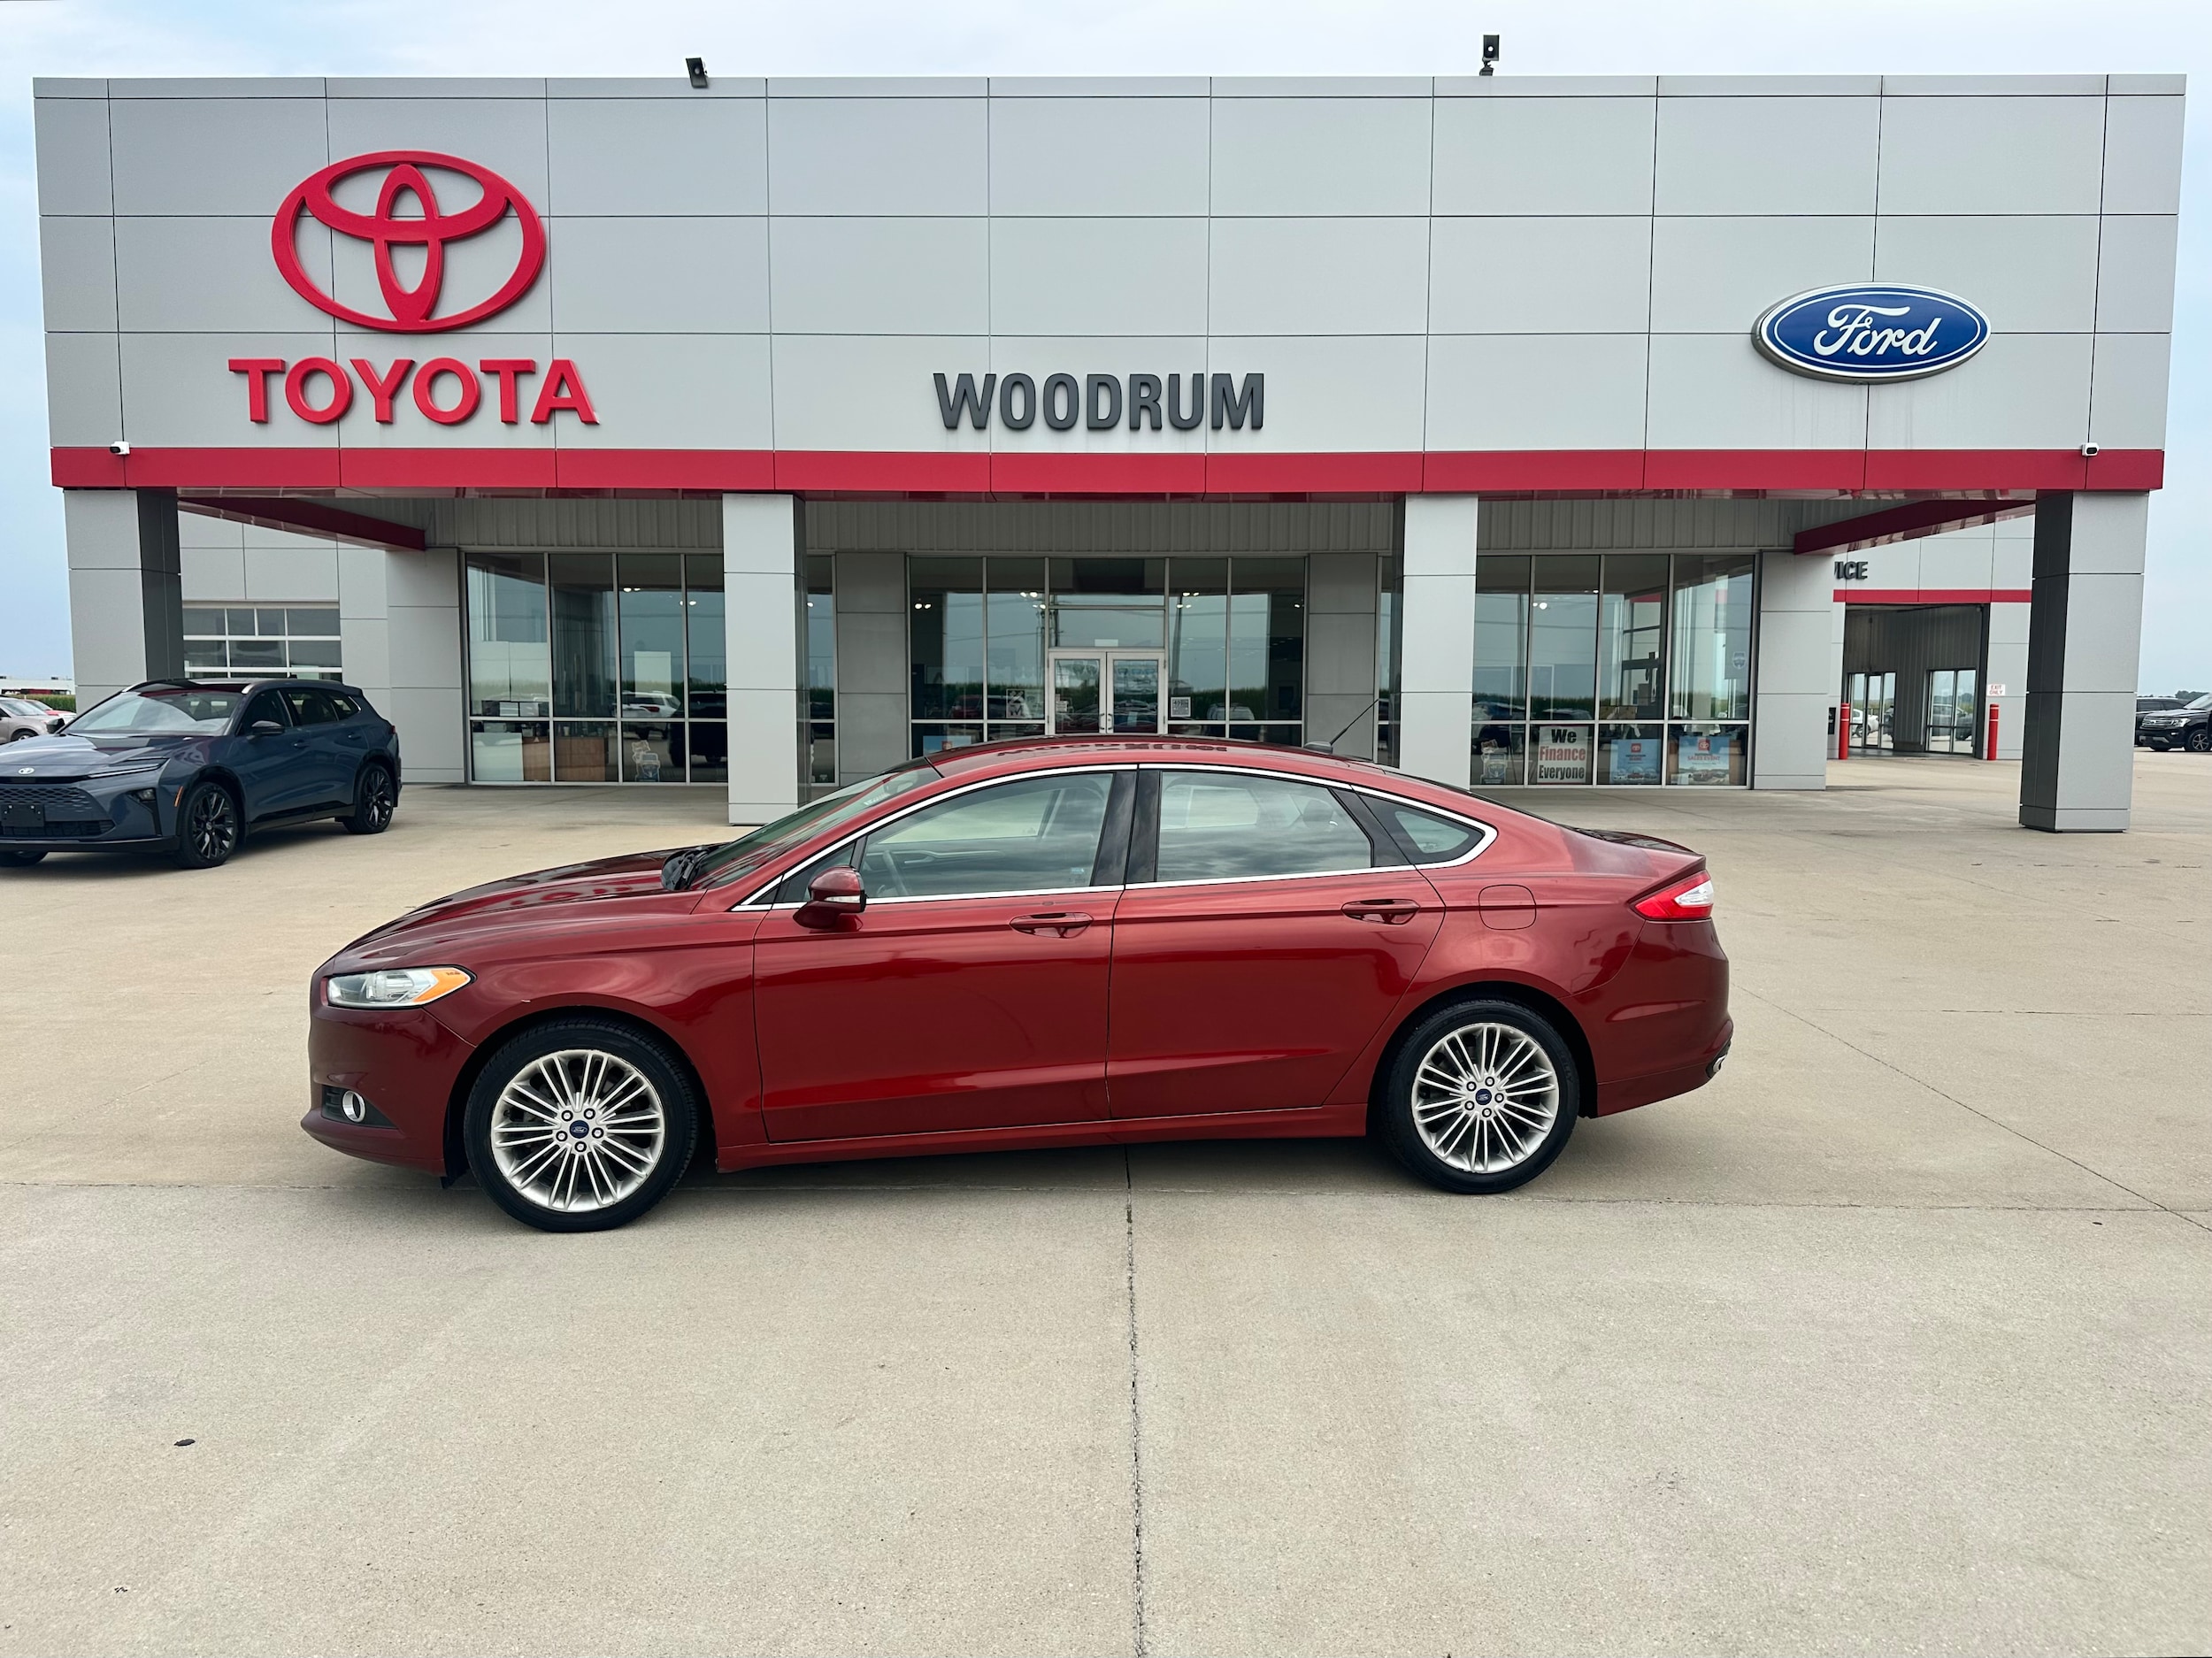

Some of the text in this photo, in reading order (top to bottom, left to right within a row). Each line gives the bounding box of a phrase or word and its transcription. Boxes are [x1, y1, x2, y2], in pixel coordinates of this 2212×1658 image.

[1814, 303, 1942, 356] Ford
[228, 357, 600, 425] TOYOTA
[933, 372, 1264, 430] WOODRUM
[1551, 728, 1577, 743] We
[1540, 746, 1586, 761] Finance
[1538, 764, 1585, 780] Everyone
